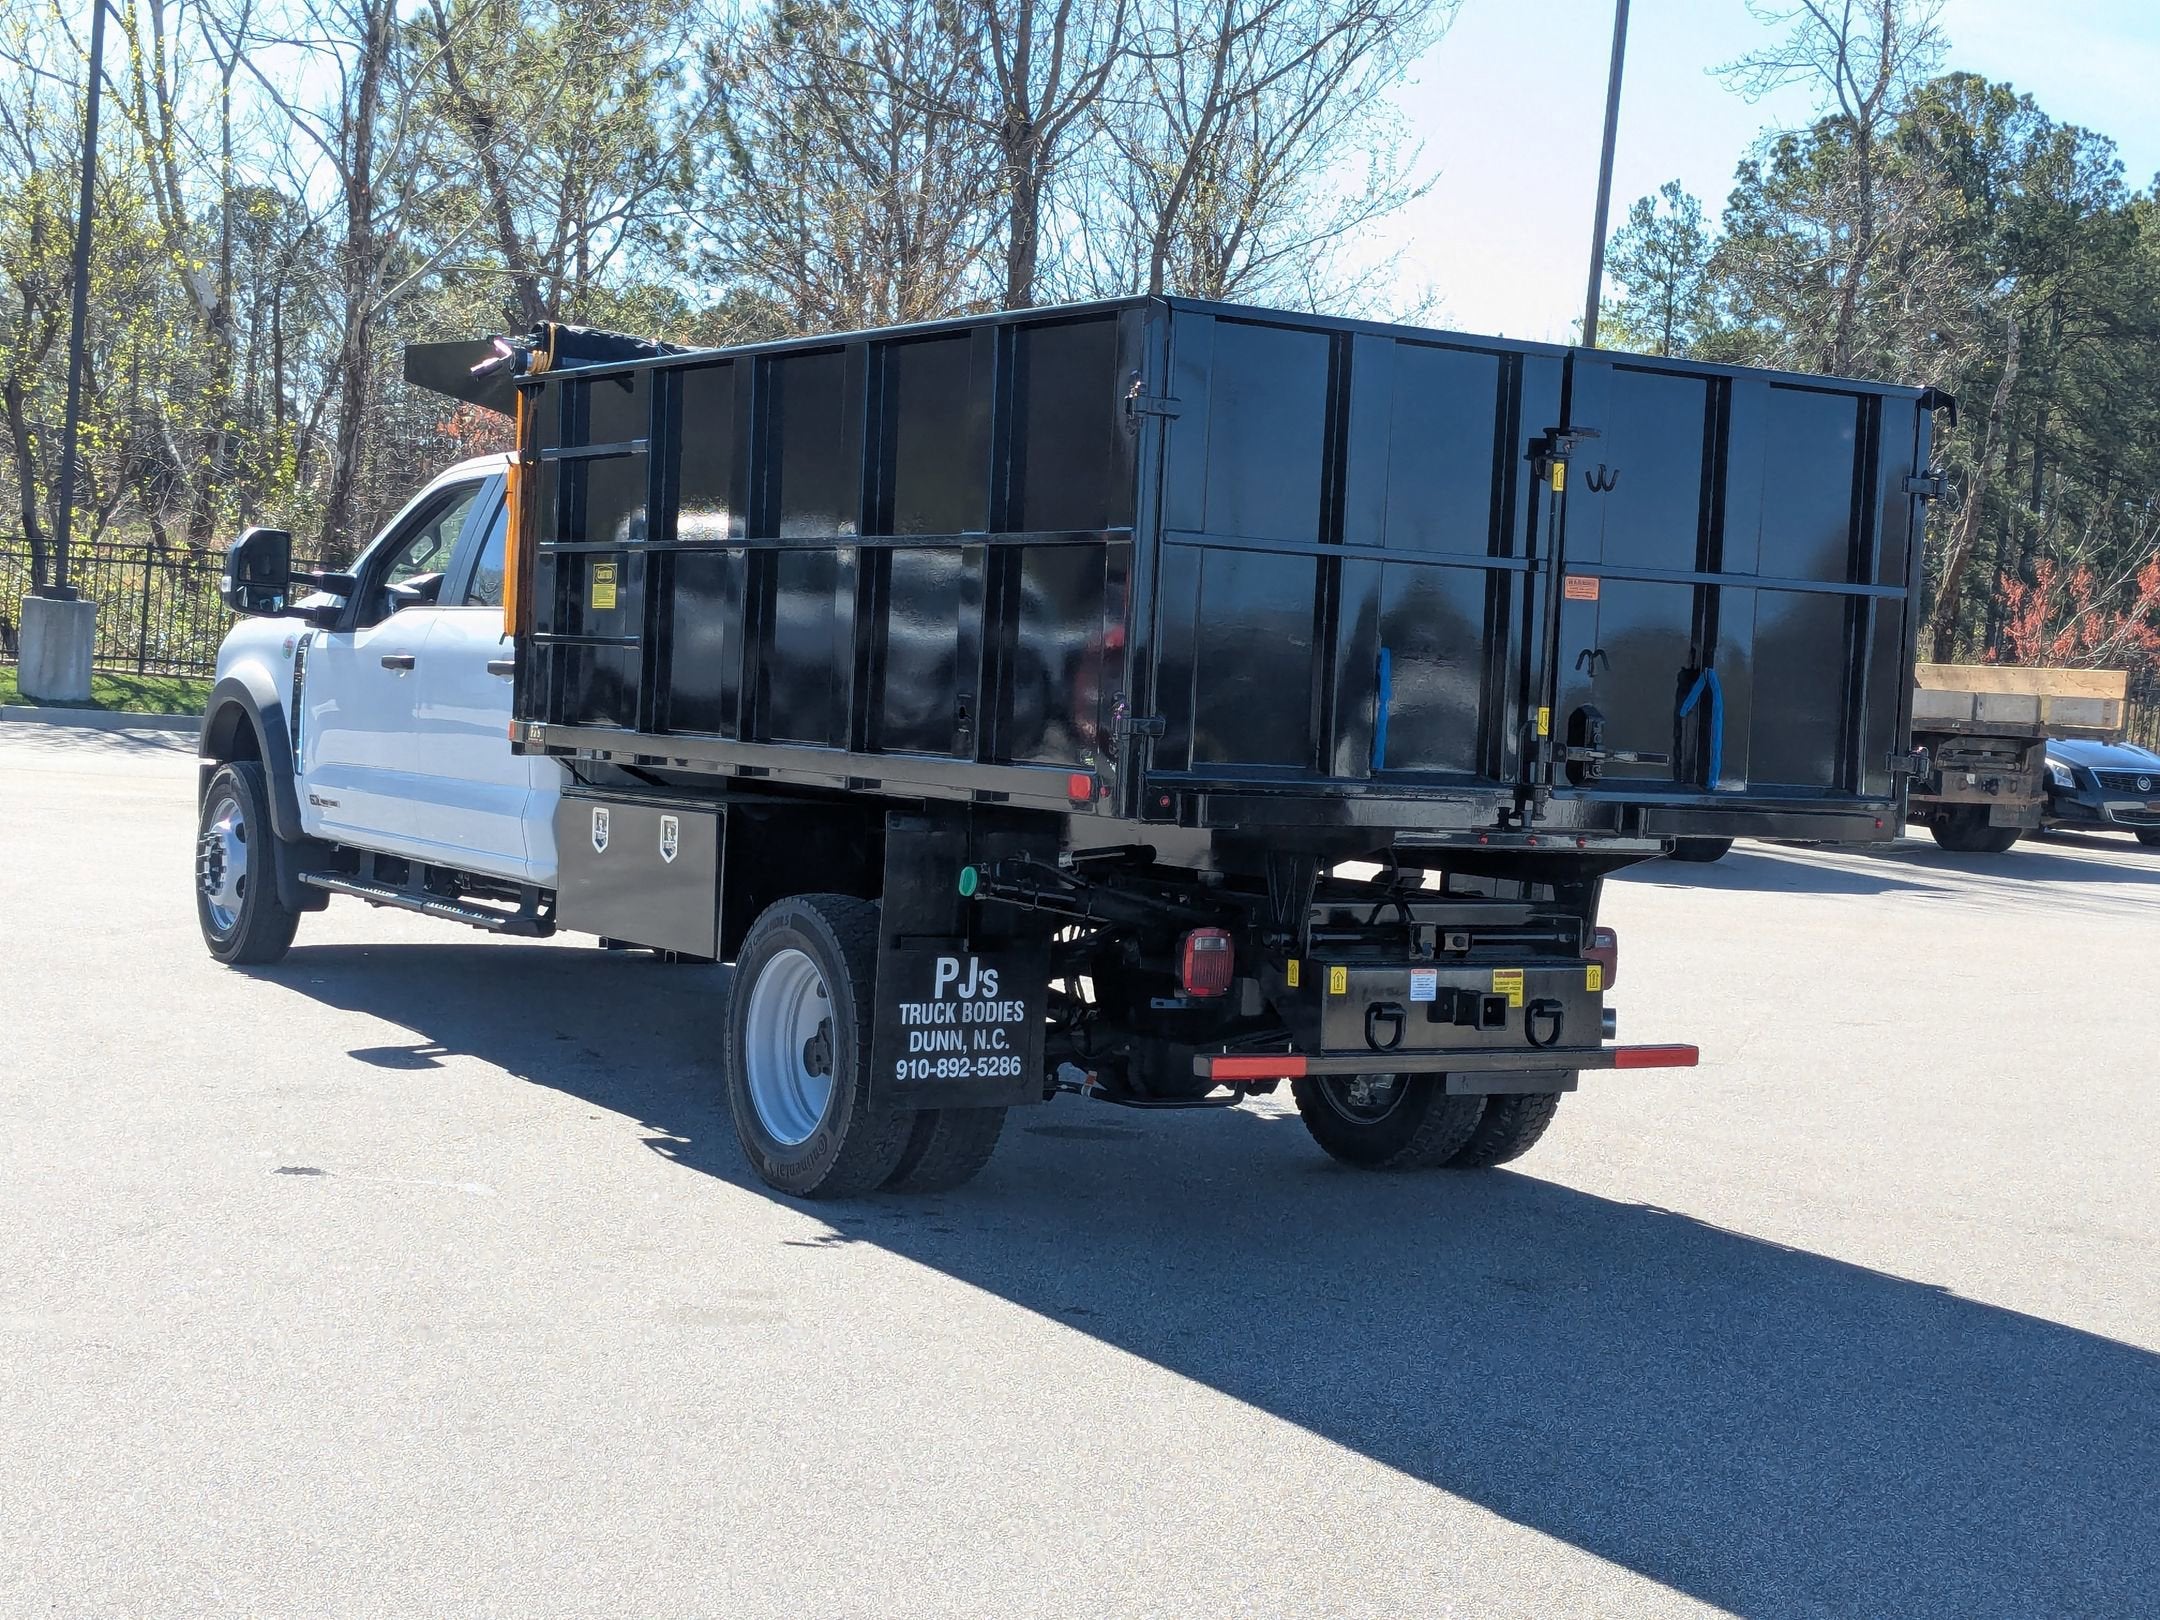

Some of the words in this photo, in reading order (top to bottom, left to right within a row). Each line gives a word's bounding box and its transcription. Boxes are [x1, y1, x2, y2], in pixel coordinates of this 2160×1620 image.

[899, 1002, 958, 1025] TRUCK
[961, 1000, 1025, 1023] BODIES
[909, 1029, 968, 1055] DUNN,
[973, 1028, 1010, 1050] N.C.
[896, 1055, 1022, 1081] 910-892-5286
